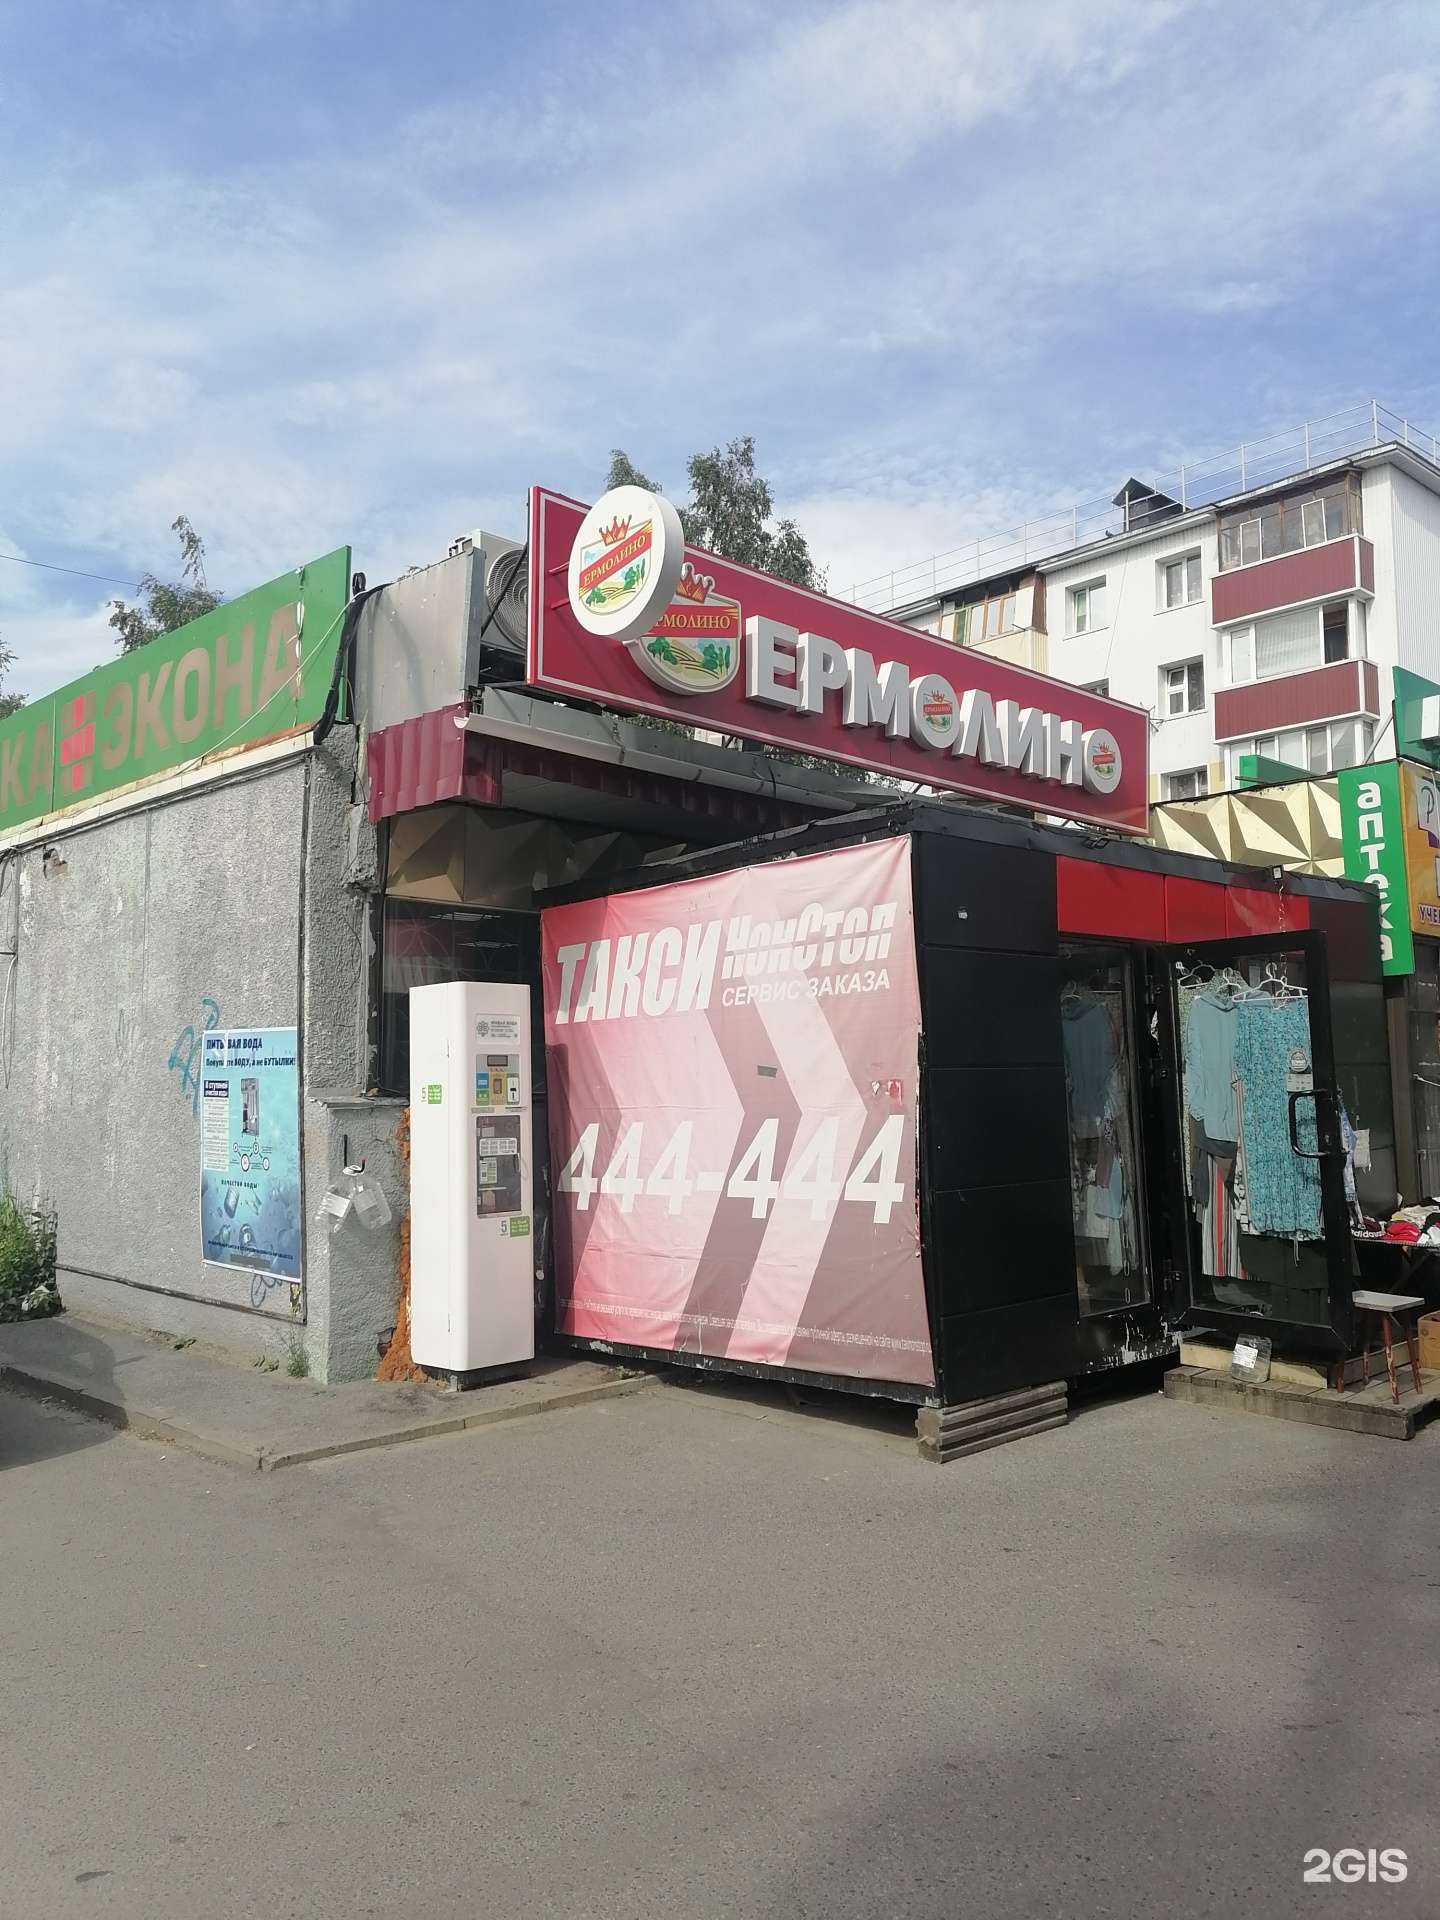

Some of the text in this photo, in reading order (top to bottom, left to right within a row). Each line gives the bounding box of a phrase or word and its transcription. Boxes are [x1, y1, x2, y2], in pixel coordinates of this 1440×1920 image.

[583, 535, 646, 586] ЕРМОЛИНО
[655, 614, 731, 629] МОЛИНО
[102, 601, 302, 770] ЭКОНА
[745, 614, 1122, 795] ЕРМОЛИНО
[1417, 905, 1440, 924] УЧЕ
[555, 919, 723, 1025] ТАКСИ
[721, 968, 891, 1007] СЕРВИС ЗАКАЗА
[205, 1057, 234, 1068] Покупате
[206, 1037, 262, 1051] ПИТЬВАЯ ВОДА
[557, 1114, 906, 1224] 444-444
